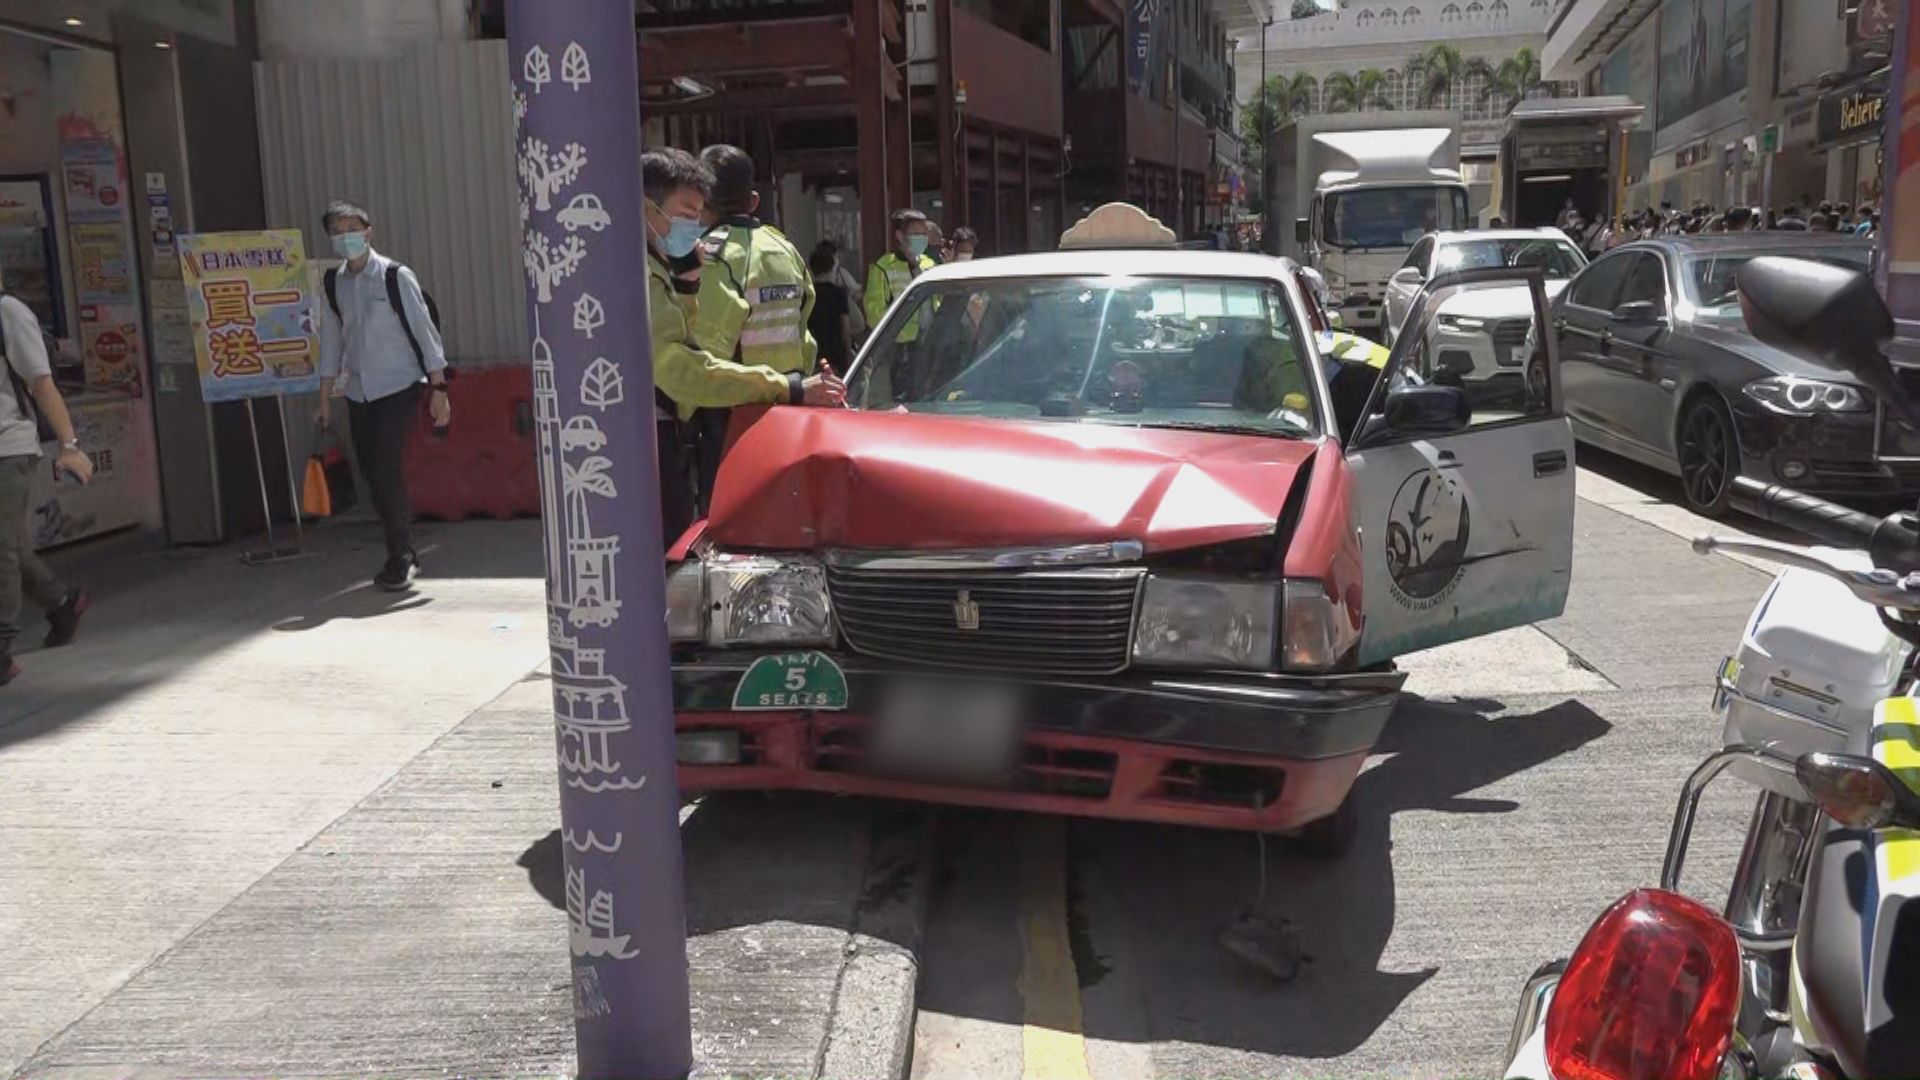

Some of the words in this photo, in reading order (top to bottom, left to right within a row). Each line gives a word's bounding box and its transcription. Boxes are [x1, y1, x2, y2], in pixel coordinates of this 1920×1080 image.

[1841, 92, 1882, 130] Believe
[203, 249, 286, 269] 日本雪糕
[202, 281, 300, 328] 買一
[210, 329, 307, 377] 送一
[785, 667, 806, 691] 5
[759, 693, 828, 705] SEATS
